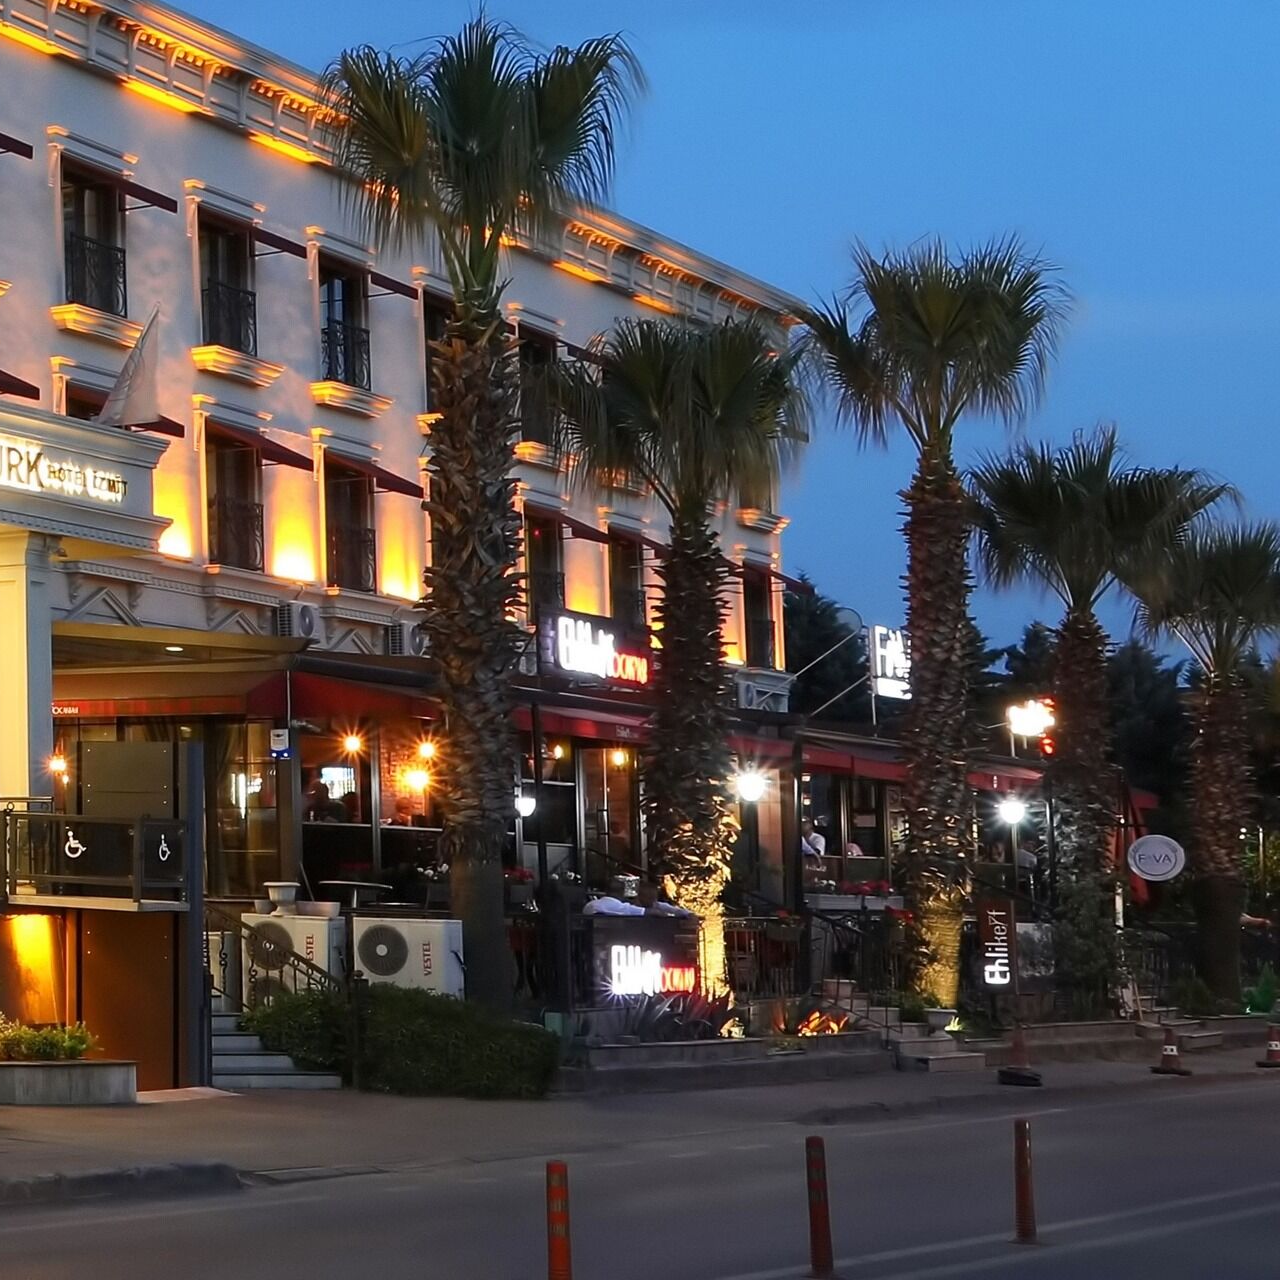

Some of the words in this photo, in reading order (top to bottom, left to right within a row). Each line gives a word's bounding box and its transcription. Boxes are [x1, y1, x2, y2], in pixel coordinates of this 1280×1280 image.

[1138, 853, 1172, 864] FVA
[305, 934, 315, 961] ESTEL
[422, 941, 433, 976] VESTEL
[983, 909, 1011, 985] Ehlikeyf
